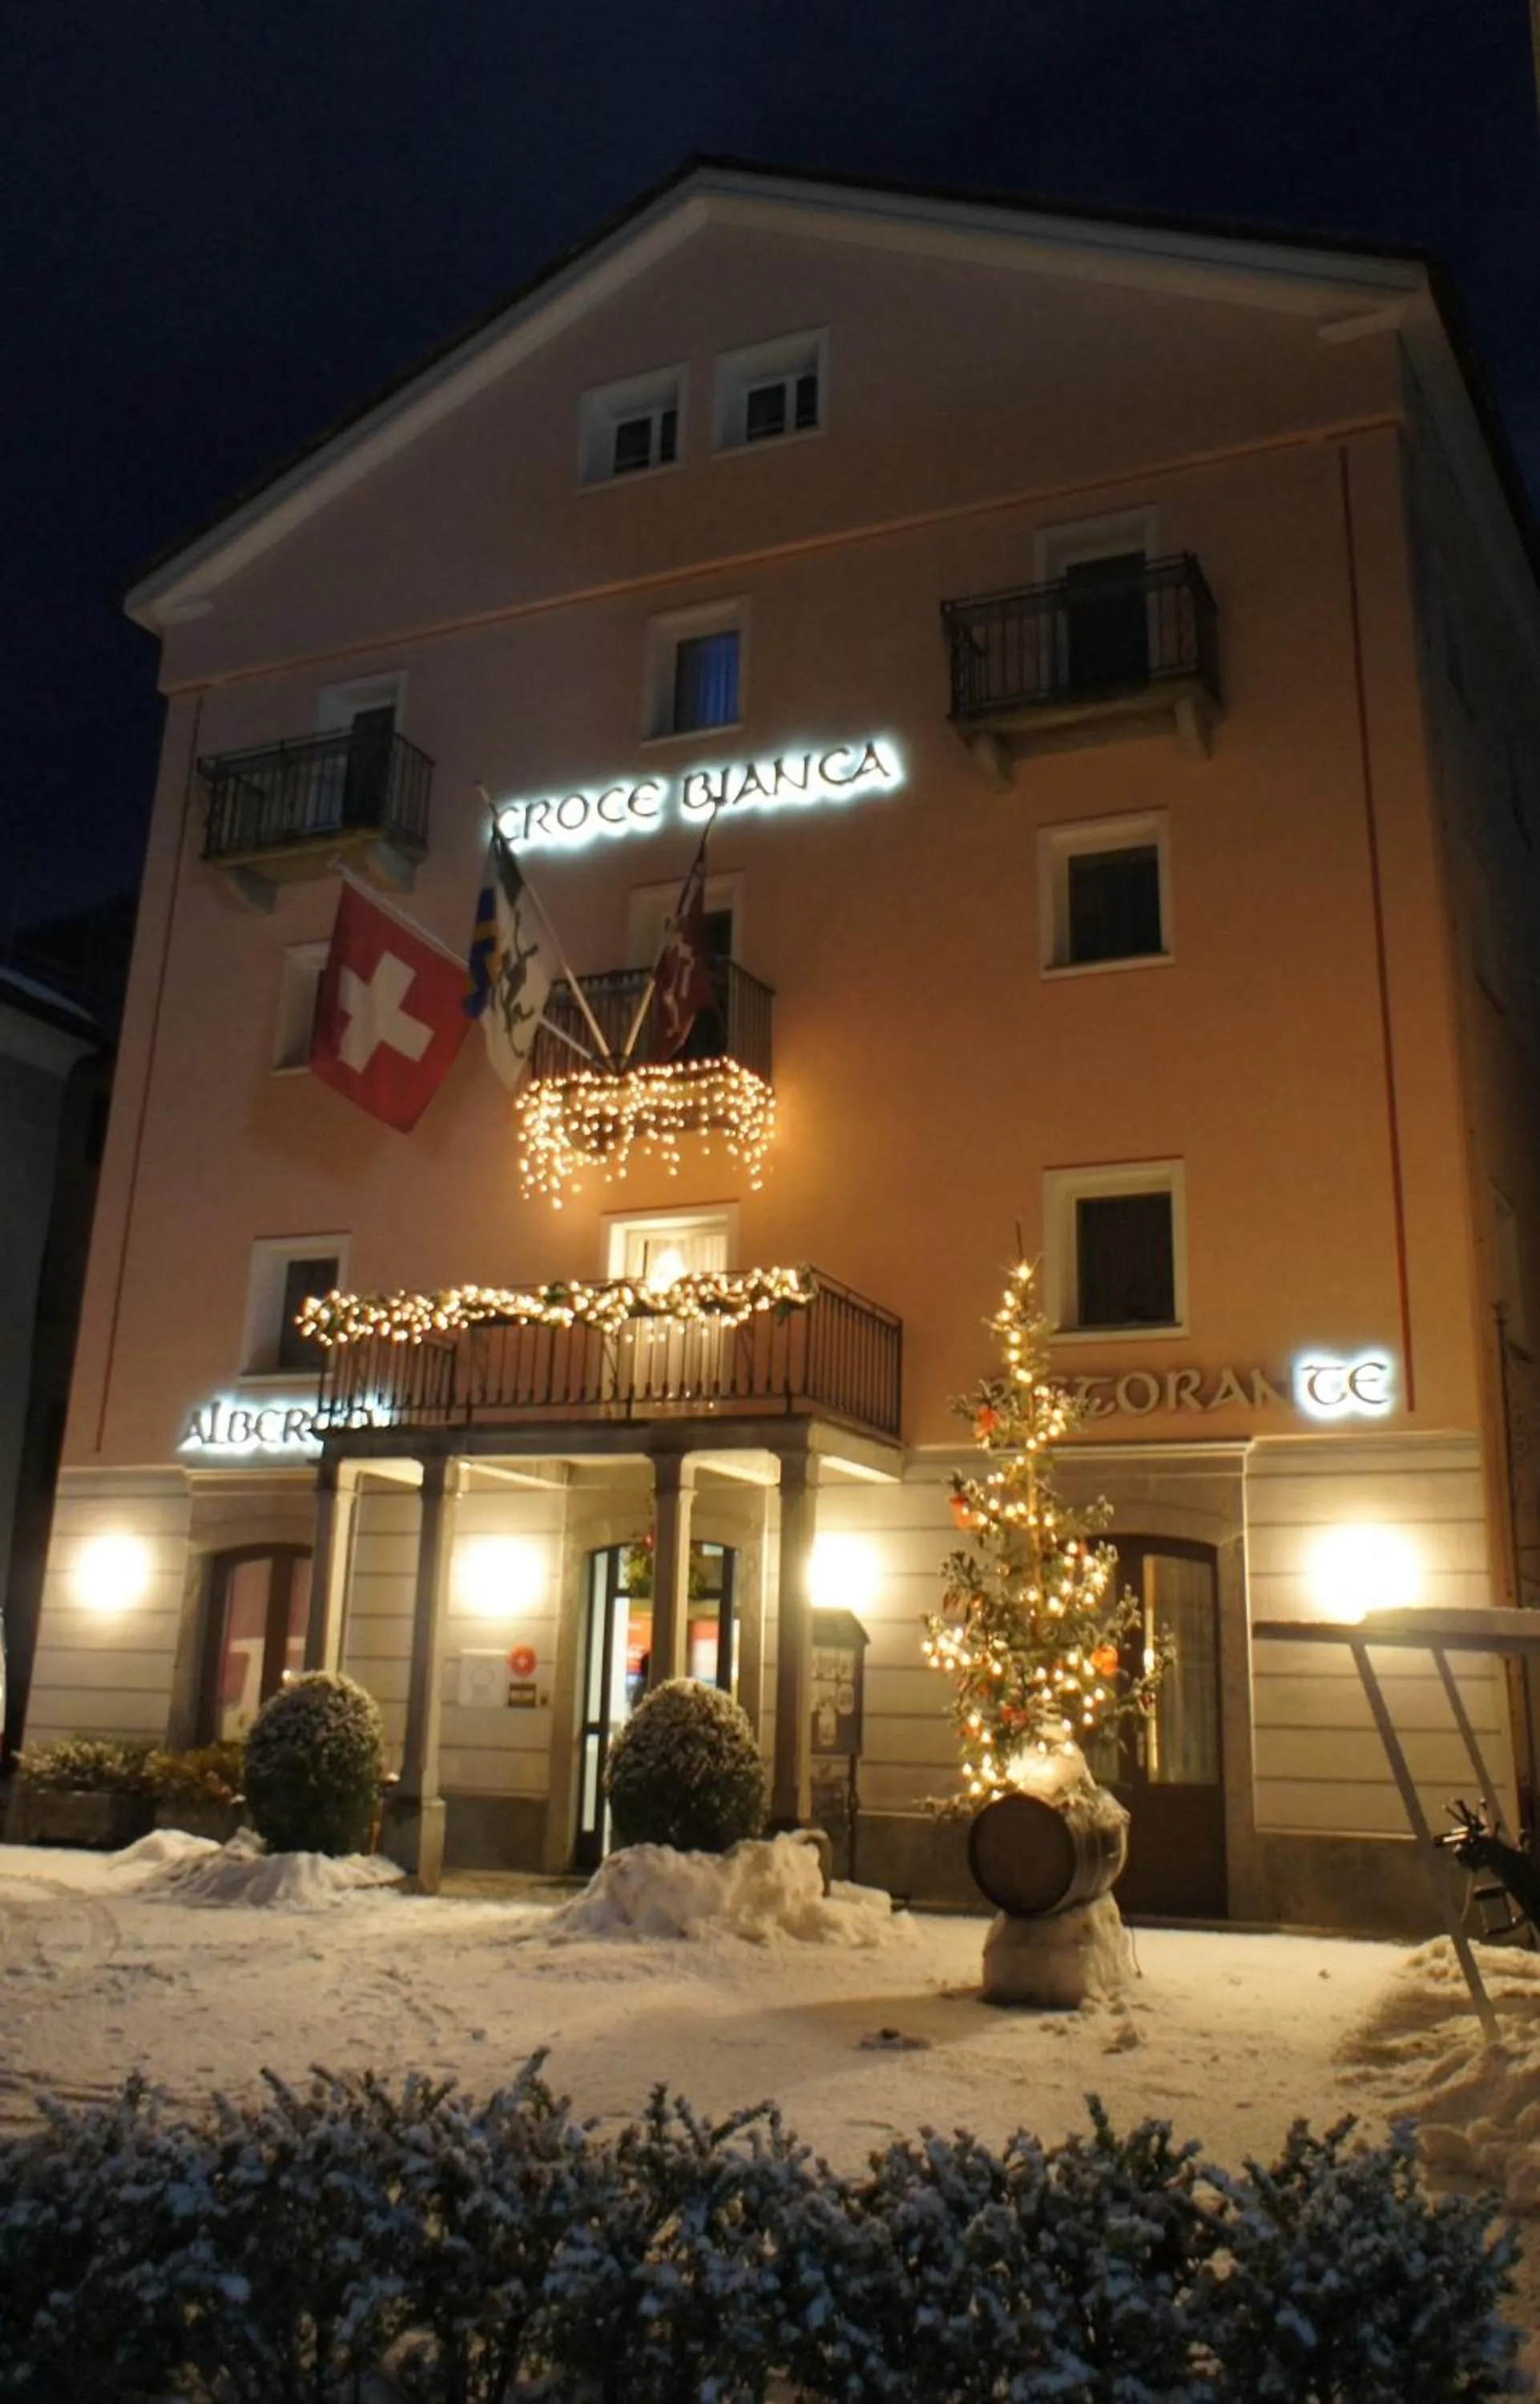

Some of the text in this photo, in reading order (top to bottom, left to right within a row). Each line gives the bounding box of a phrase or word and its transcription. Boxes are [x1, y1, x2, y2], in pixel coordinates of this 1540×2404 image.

[493, 740, 891, 841] CROCE BIANCA
[986, 1361, 1389, 1417] RTORANTE
